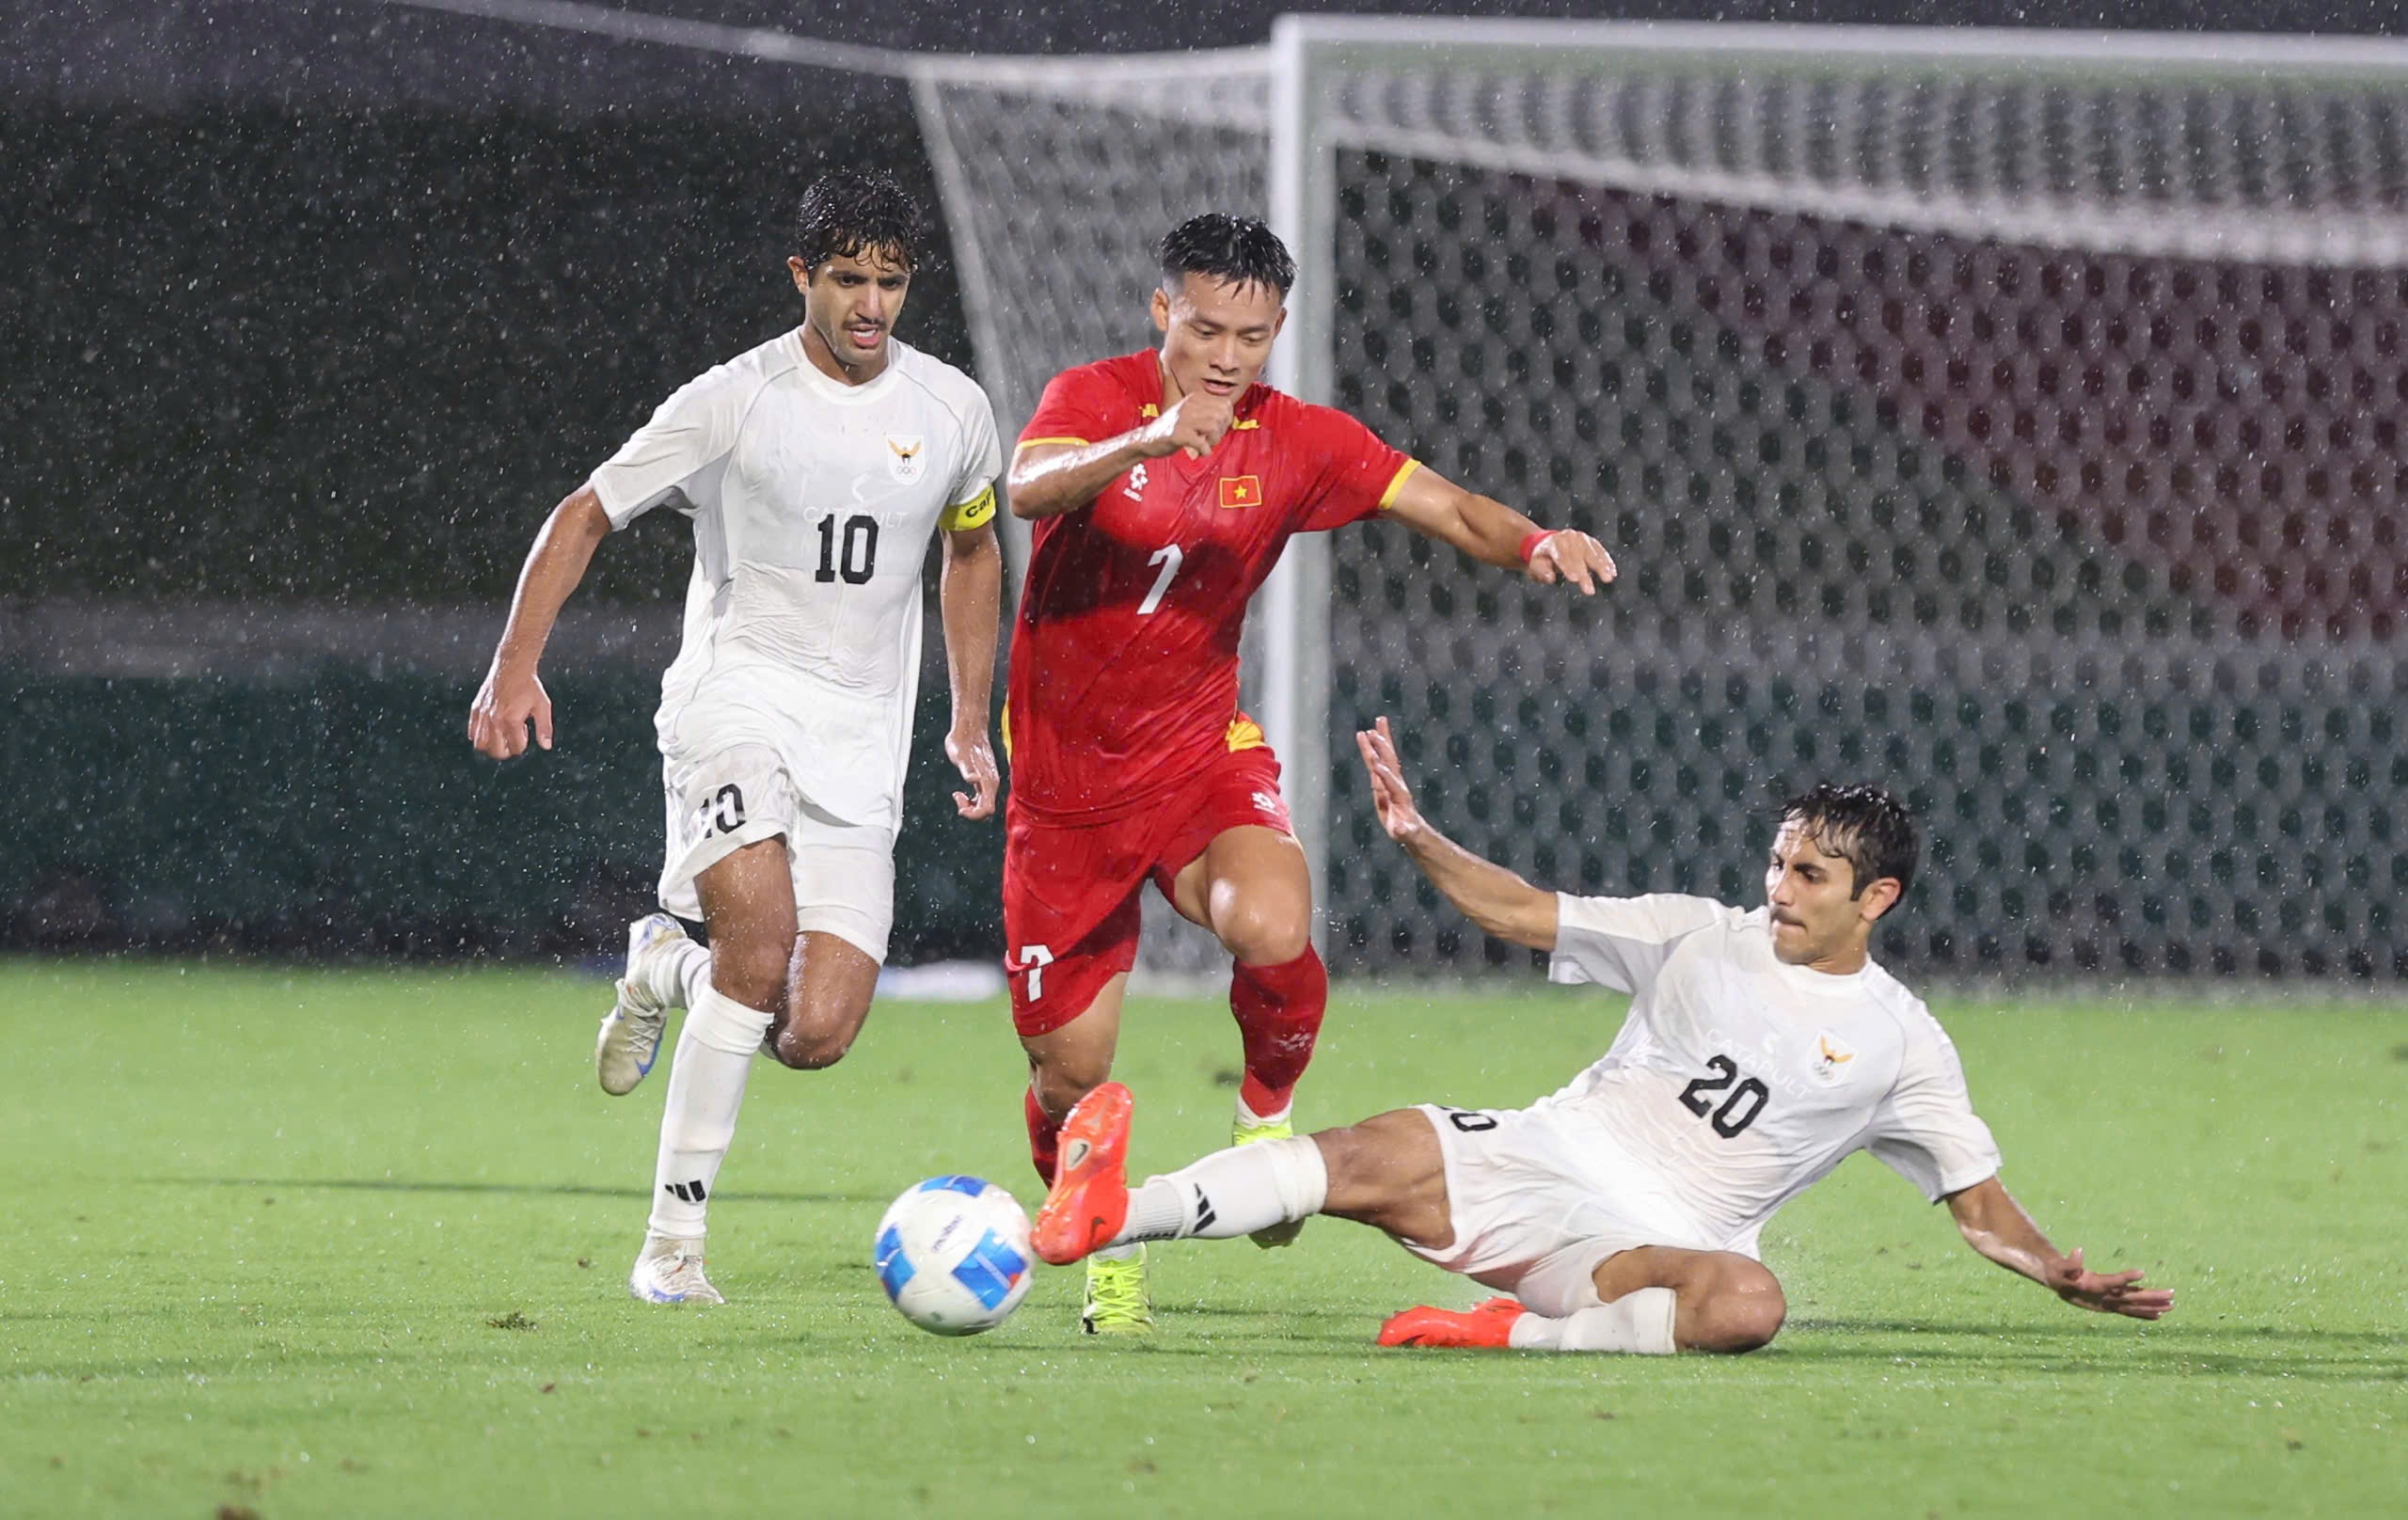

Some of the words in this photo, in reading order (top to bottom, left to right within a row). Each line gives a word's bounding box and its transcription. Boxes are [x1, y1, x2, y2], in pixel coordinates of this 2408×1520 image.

[816, 514, 879, 585] 10
[1136, 544, 1183, 614] 7
[1020, 944, 1054, 1003] 7
[1679, 1054, 1769, 1139] 20
